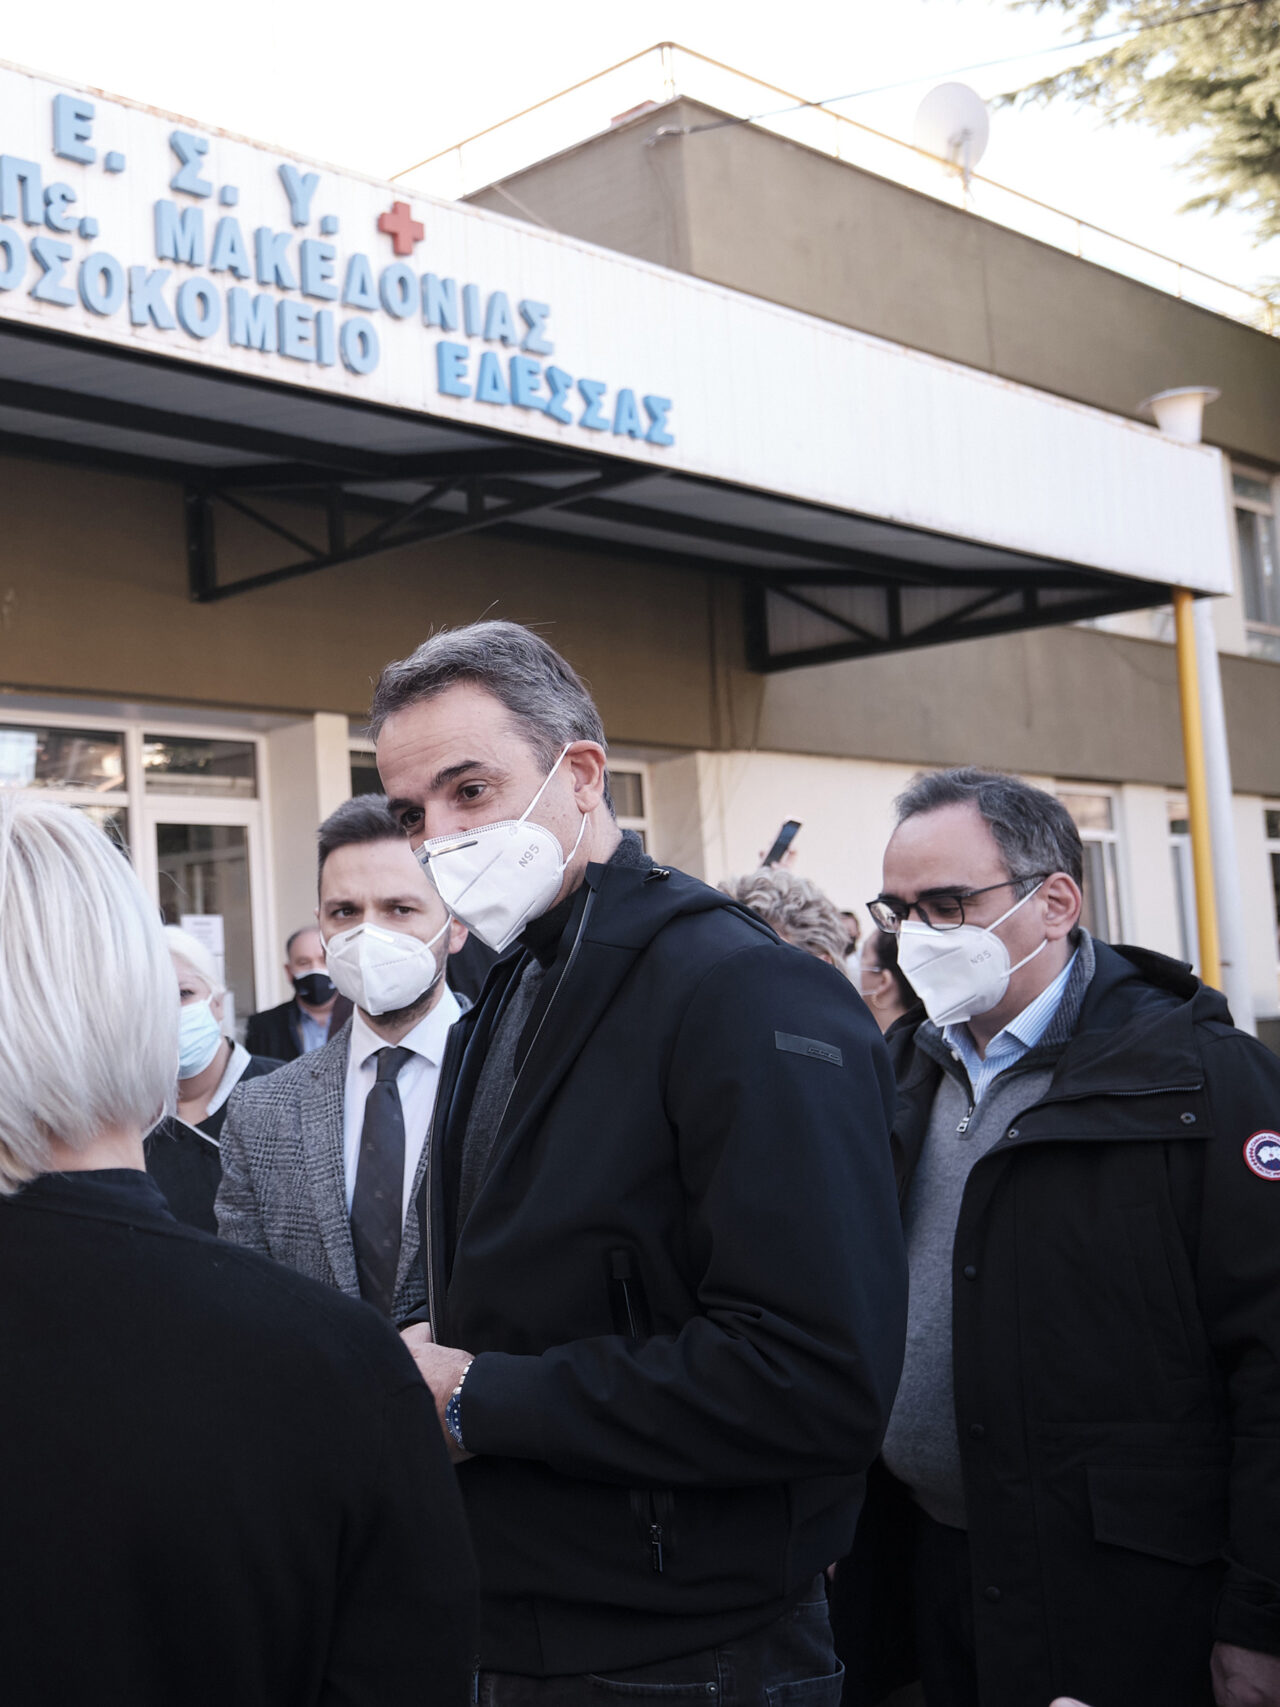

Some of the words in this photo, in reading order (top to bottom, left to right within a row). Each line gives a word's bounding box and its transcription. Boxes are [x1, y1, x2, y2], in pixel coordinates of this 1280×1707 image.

[53, 93, 126, 173] Ε.
[170, 130, 238, 206] Σ.
[278, 164, 339, 235] Υ.
[155, 199, 554, 355] ΜΑΚΕΔΟΝΙΑΣ
[434, 340, 676, 447] ΕΔΕΣΣΑΣ
[518, 843, 541, 868] N95
